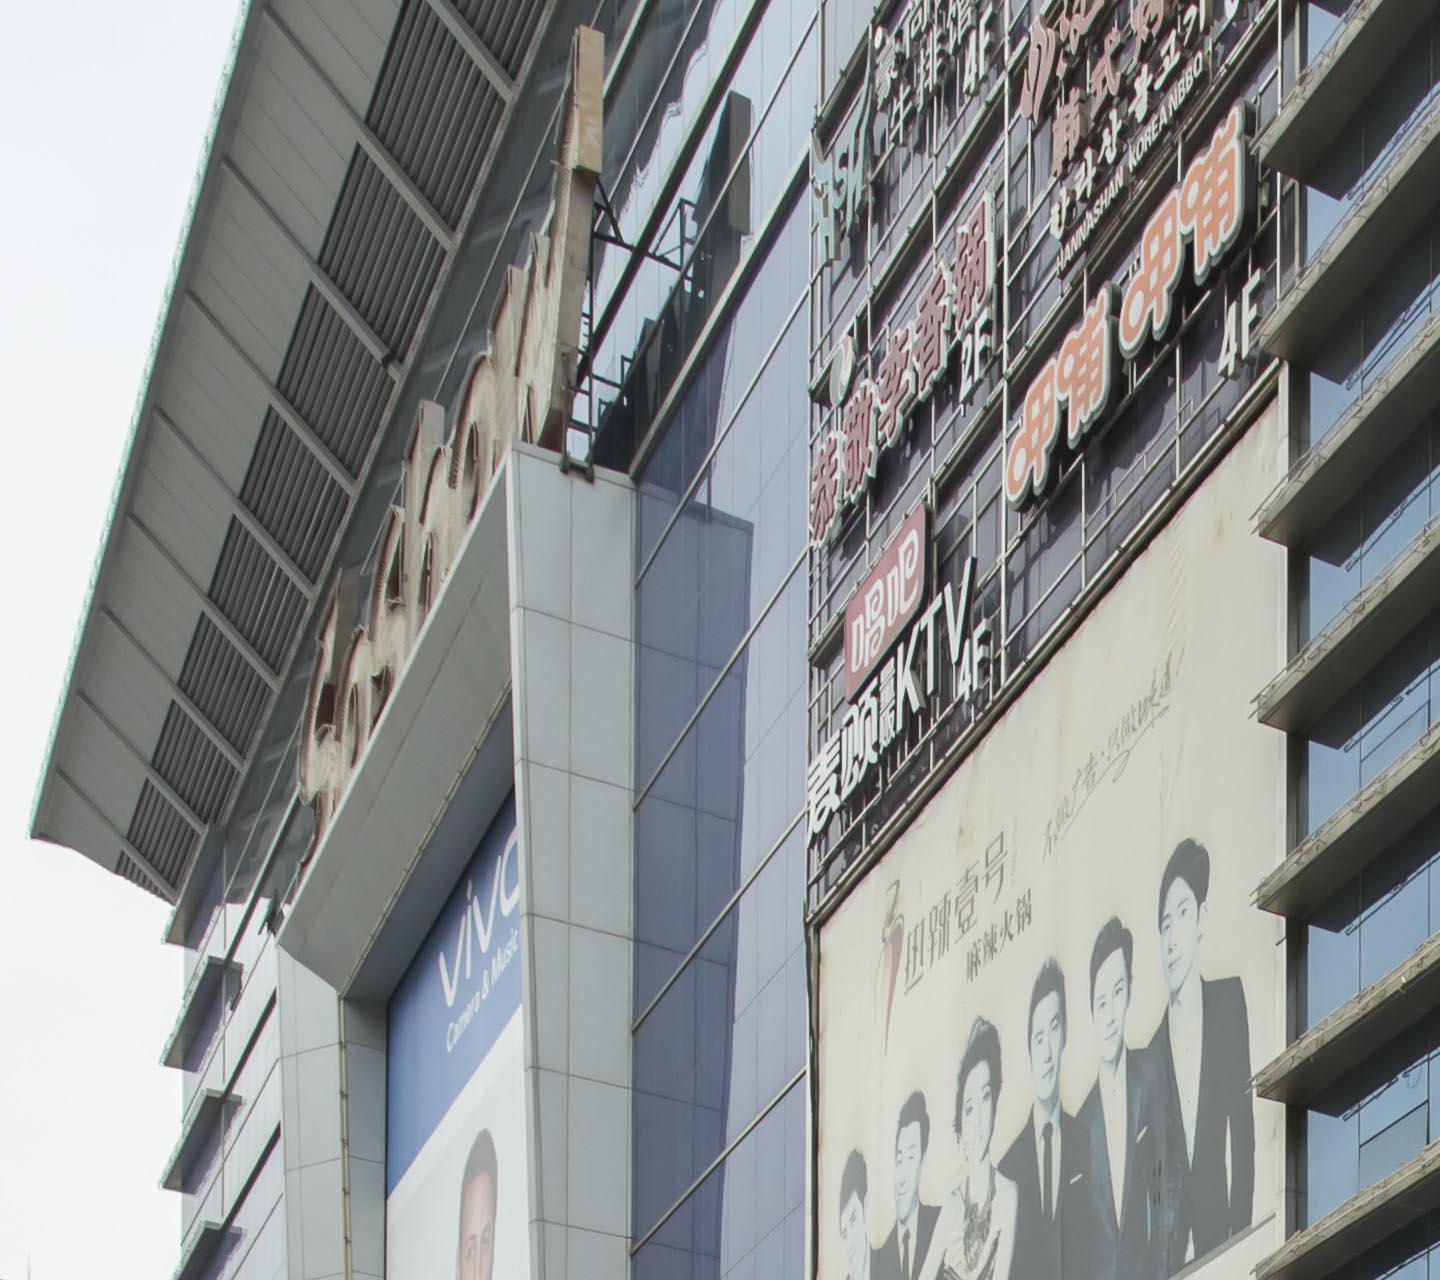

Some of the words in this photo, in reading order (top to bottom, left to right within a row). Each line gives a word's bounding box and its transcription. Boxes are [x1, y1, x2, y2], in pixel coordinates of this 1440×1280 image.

[960, 308, 992, 402] 2F
[1007, 104, 1246, 502] 呷哺呷哺
[1218, 268, 1262, 379] 4F
[897, 556, 977, 735] KTV
[960, 617, 991, 702] 4F
[446, 988, 481, 1053] Camera
[491, 926, 519, 987] Music
